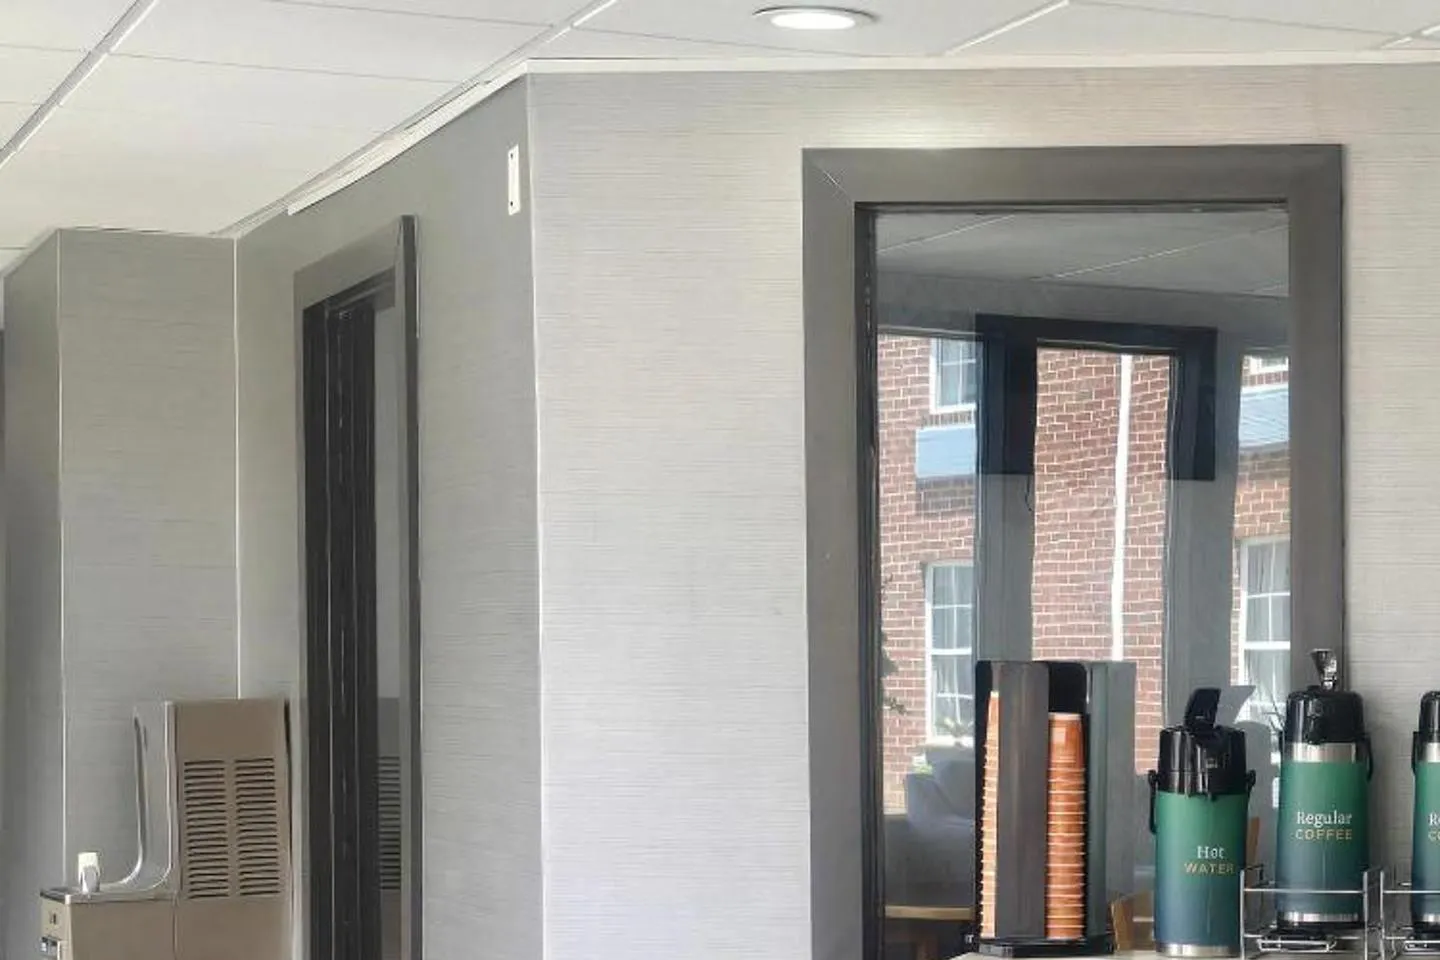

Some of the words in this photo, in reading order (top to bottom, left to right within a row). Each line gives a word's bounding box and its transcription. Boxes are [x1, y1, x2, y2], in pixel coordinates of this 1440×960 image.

[1296, 809, 1353, 828] Regular
[1295, 828, 1353, 840] COFFEE
[1196, 845, 1225, 860] Hot
[1184, 862, 1235, 875] WATER
